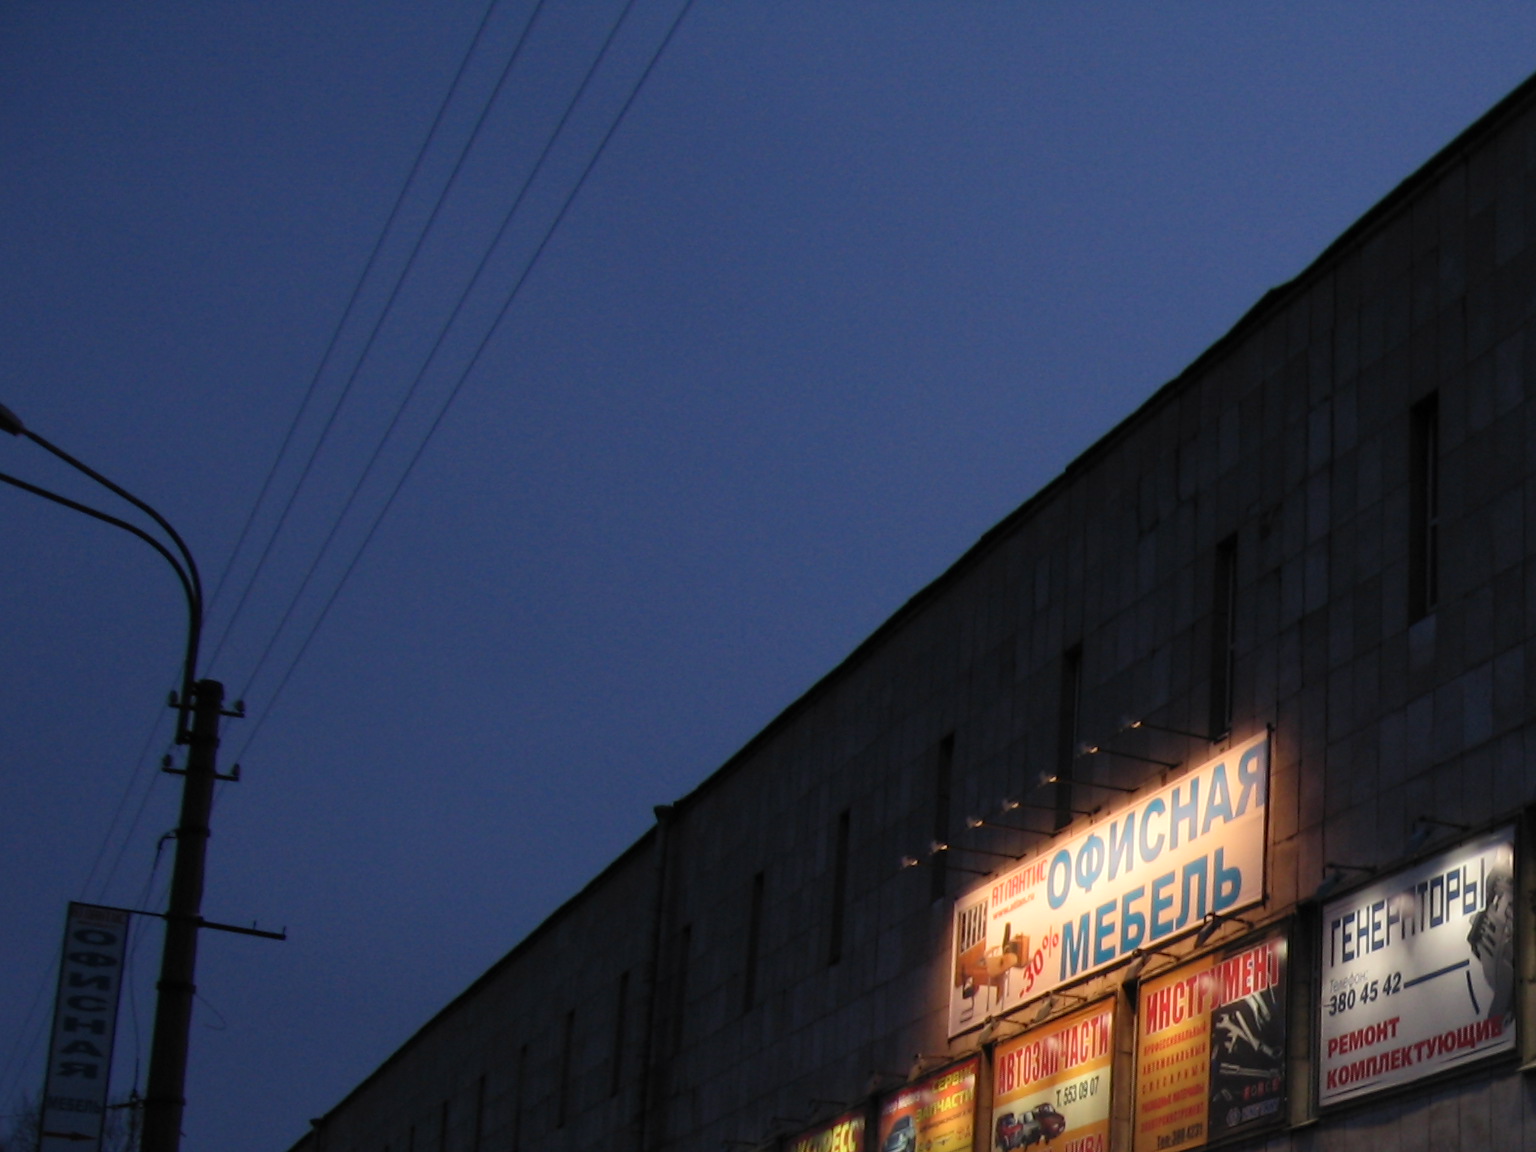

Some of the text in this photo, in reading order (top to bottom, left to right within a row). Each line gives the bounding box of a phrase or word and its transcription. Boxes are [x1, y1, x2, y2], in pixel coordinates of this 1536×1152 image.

[1047, 739, 1267, 910] ОФИСНАЯ
[992, 859, 1048, 908] АТЛАНТИС
[1060, 847, 1242, 981] МЕБЕЛЬ
[1329, 971, 1402, 1016] 380 45 42
[998, 1012, 1112, 1095] АВТОЗАПЧАСТИ
[1327, 1016, 1503, 1090] КОМПЛЕКТУЮЩИЕ
[1328, 1017, 1400, 1058] РЕМОНТ
